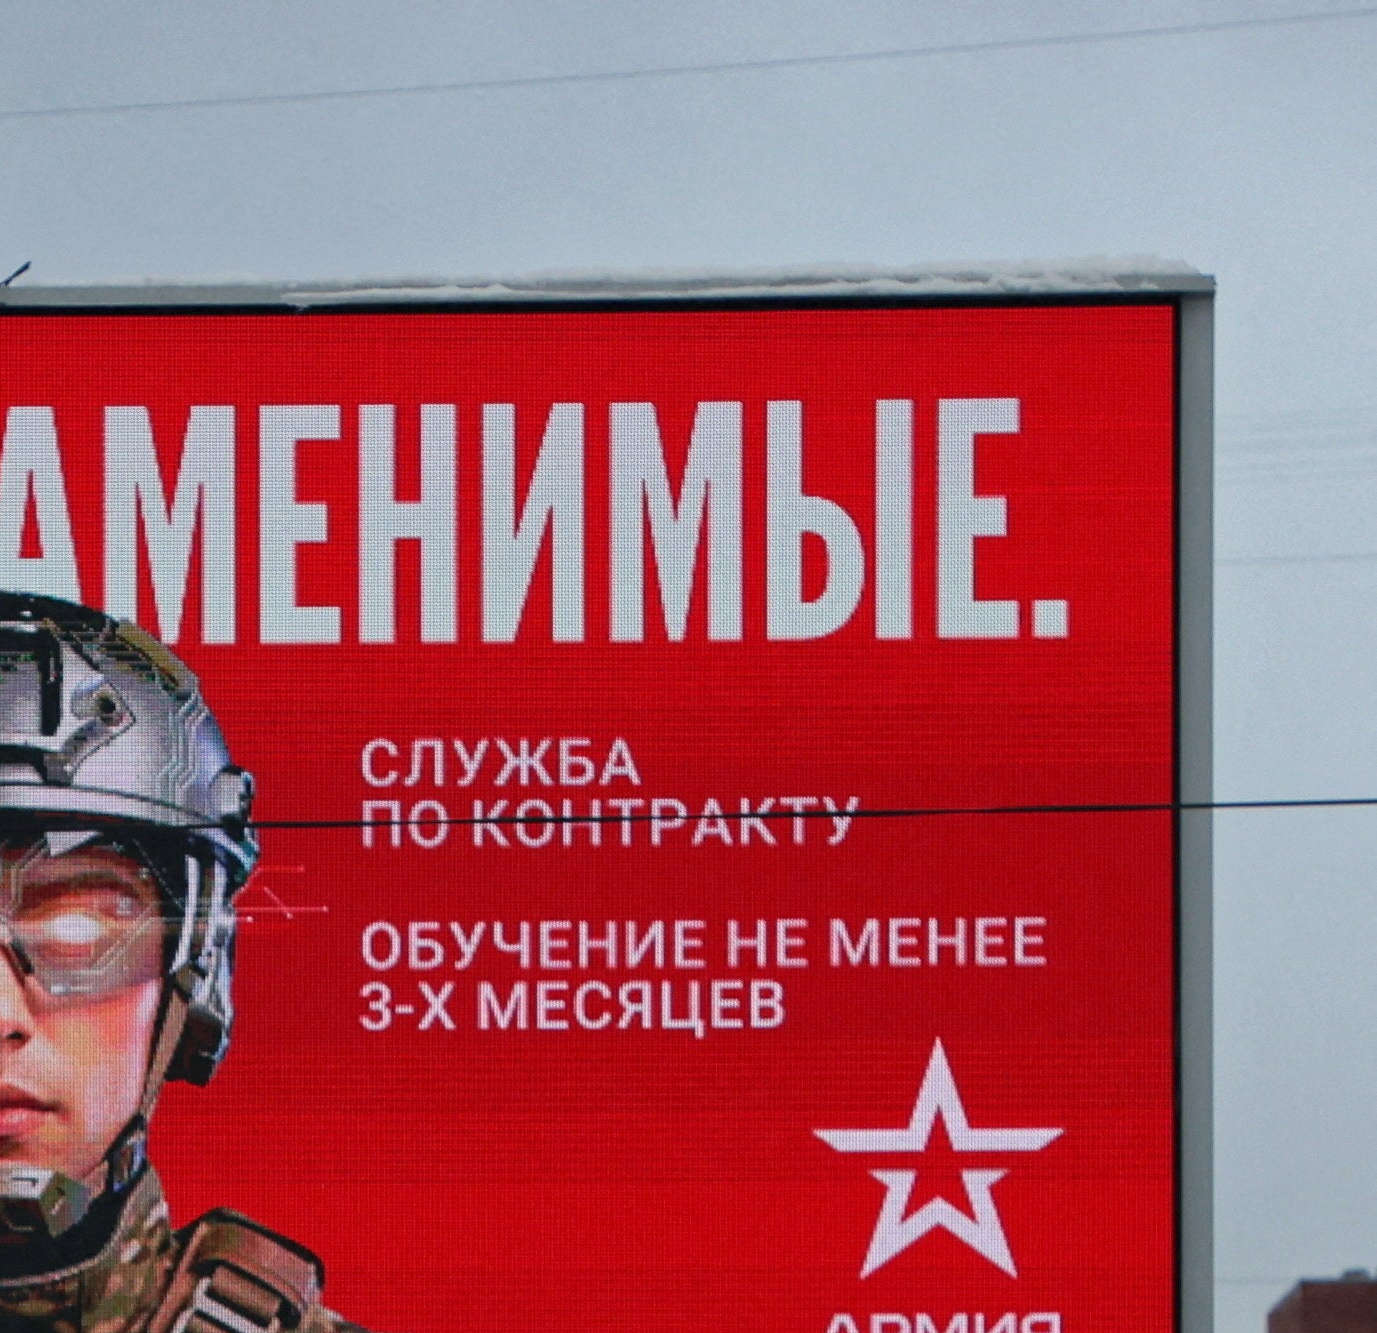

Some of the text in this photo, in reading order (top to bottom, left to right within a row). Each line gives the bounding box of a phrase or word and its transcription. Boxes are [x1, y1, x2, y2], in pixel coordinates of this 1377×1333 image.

[362, 739, 640, 786] СЛУЖБА
[363, 797, 858, 847] ПО КОНТРАКТУ
[363, 917, 1045, 969] ОБУЧЕНИЕ НЕ МЕНЕЕ
[362, 980, 783, 1038] 3-Х МЕСЯЦЕВ
